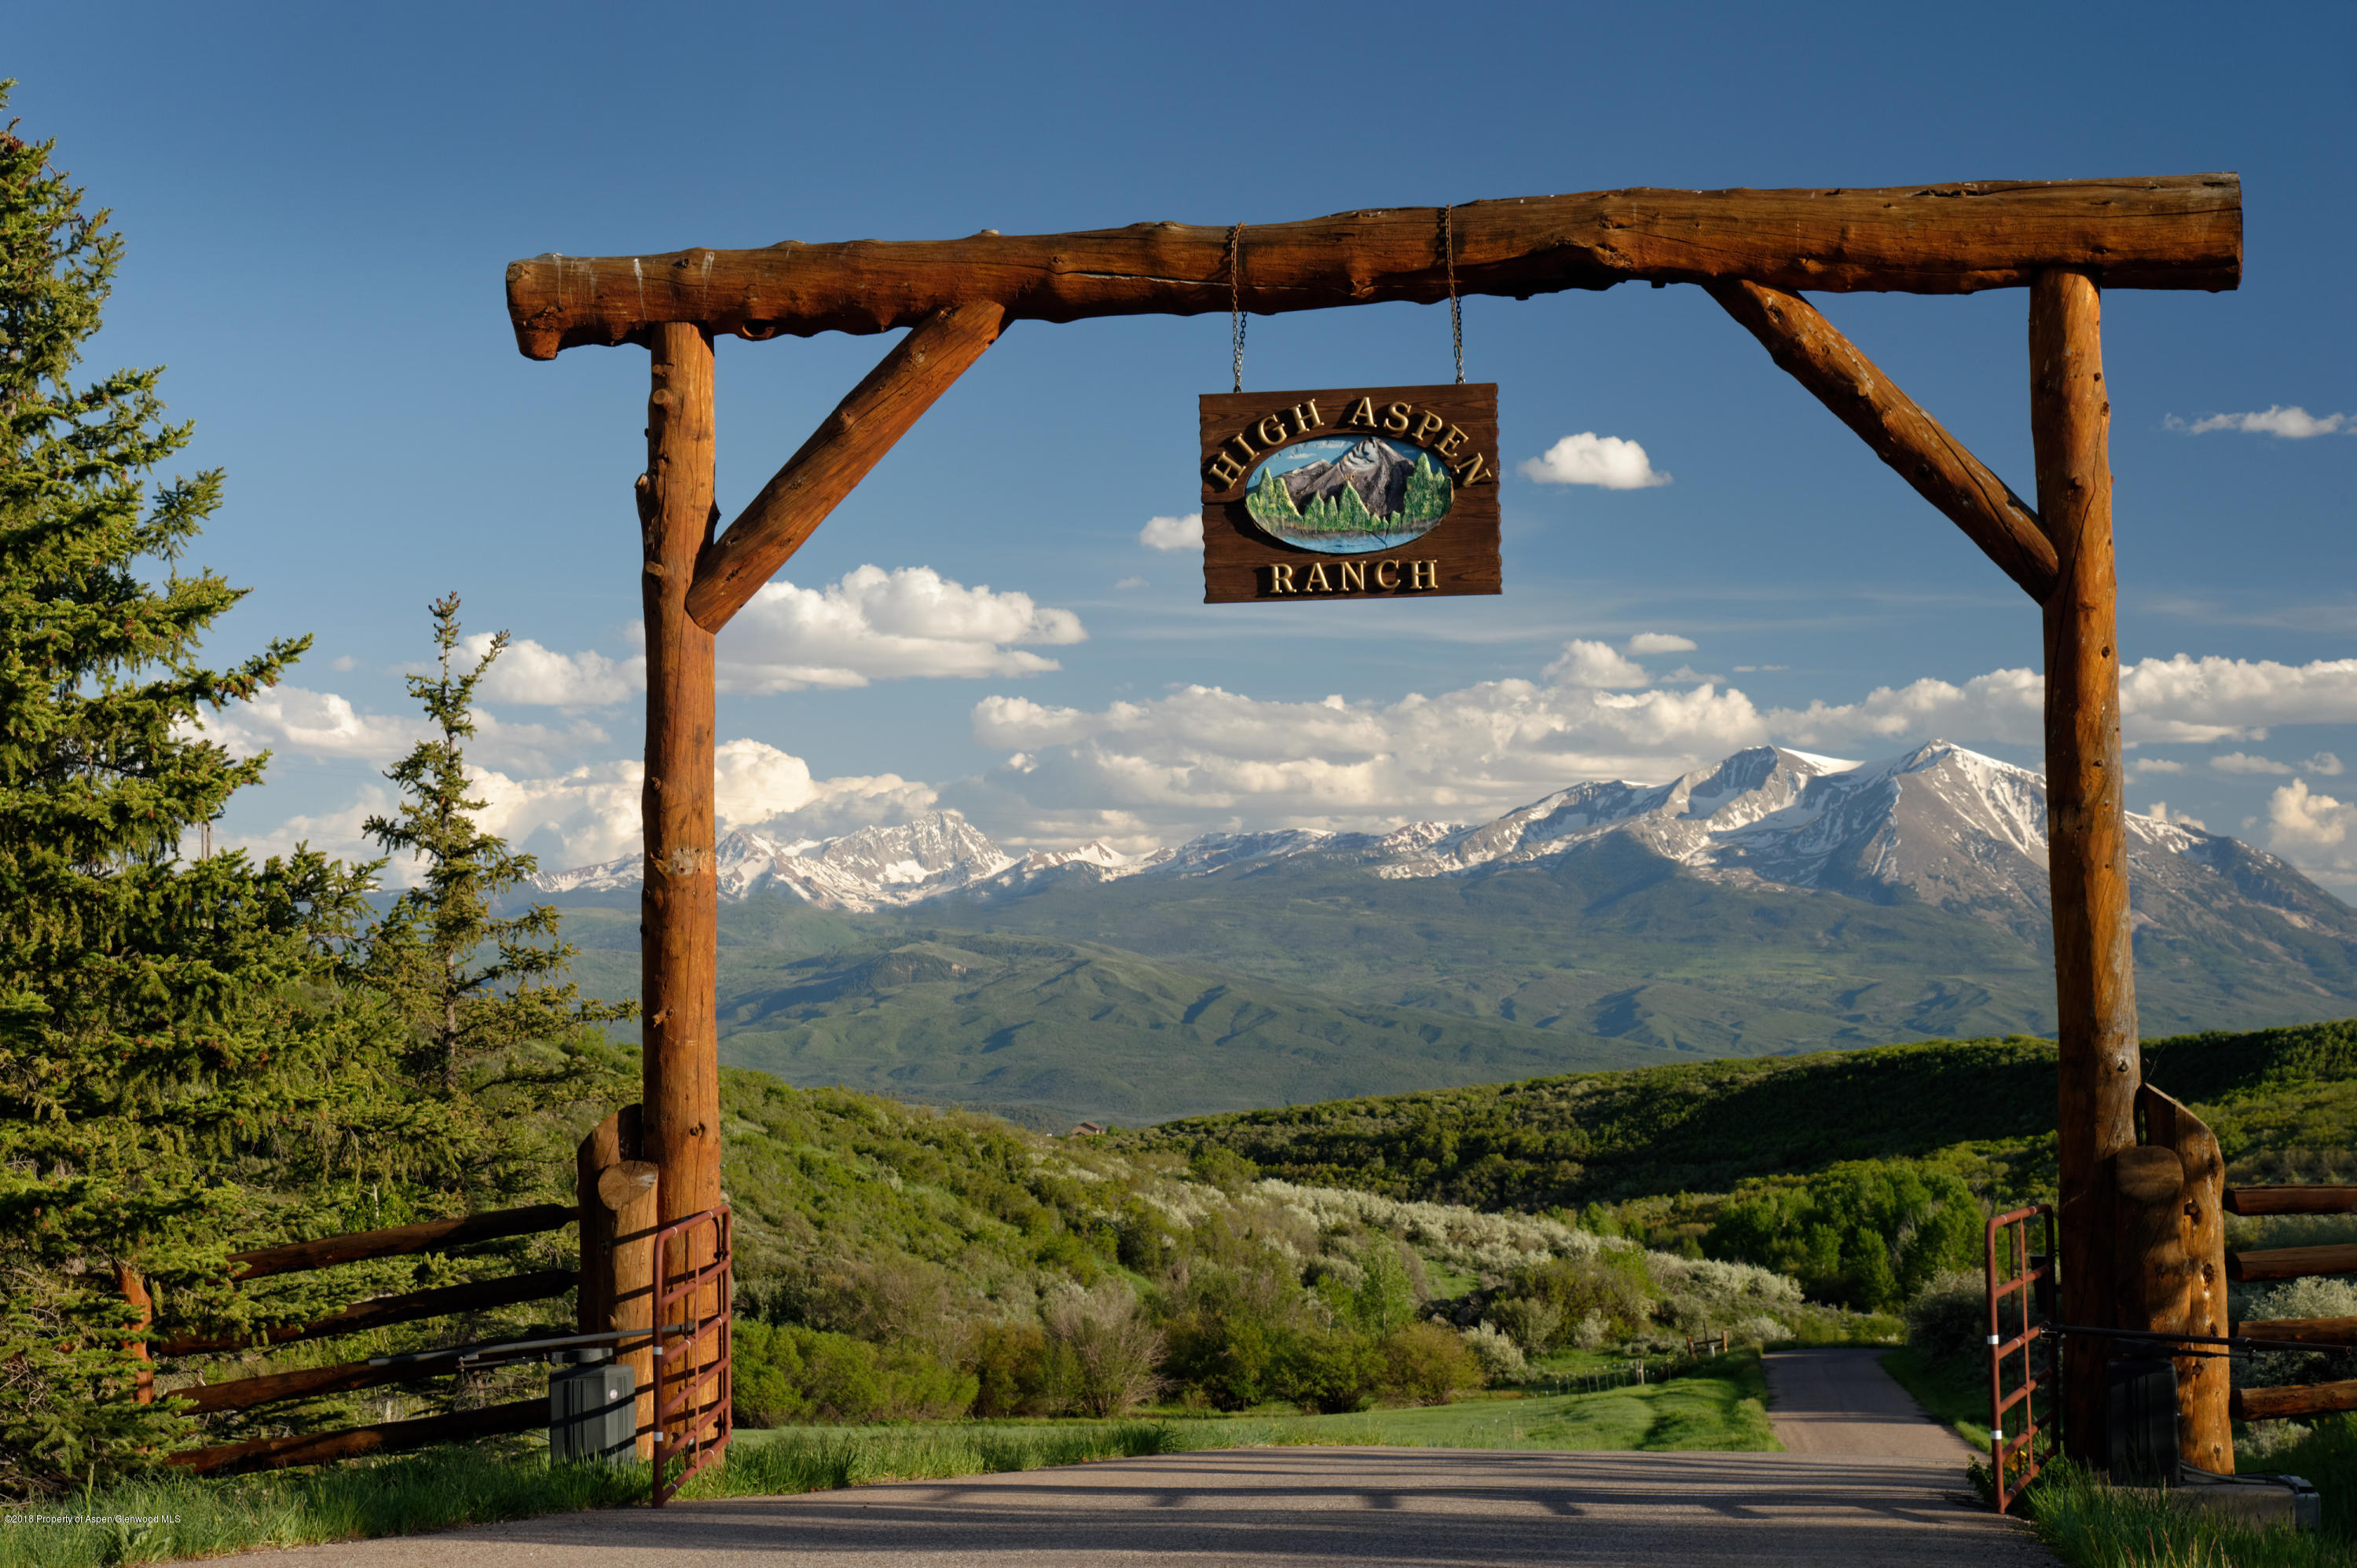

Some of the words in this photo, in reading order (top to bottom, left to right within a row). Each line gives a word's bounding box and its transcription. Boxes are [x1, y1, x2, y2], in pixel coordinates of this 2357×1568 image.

[1208, 399, 1325, 490] HIGH
[1347, 397, 1491, 488] ASPEN
[1270, 559, 1439, 594] RANCH
